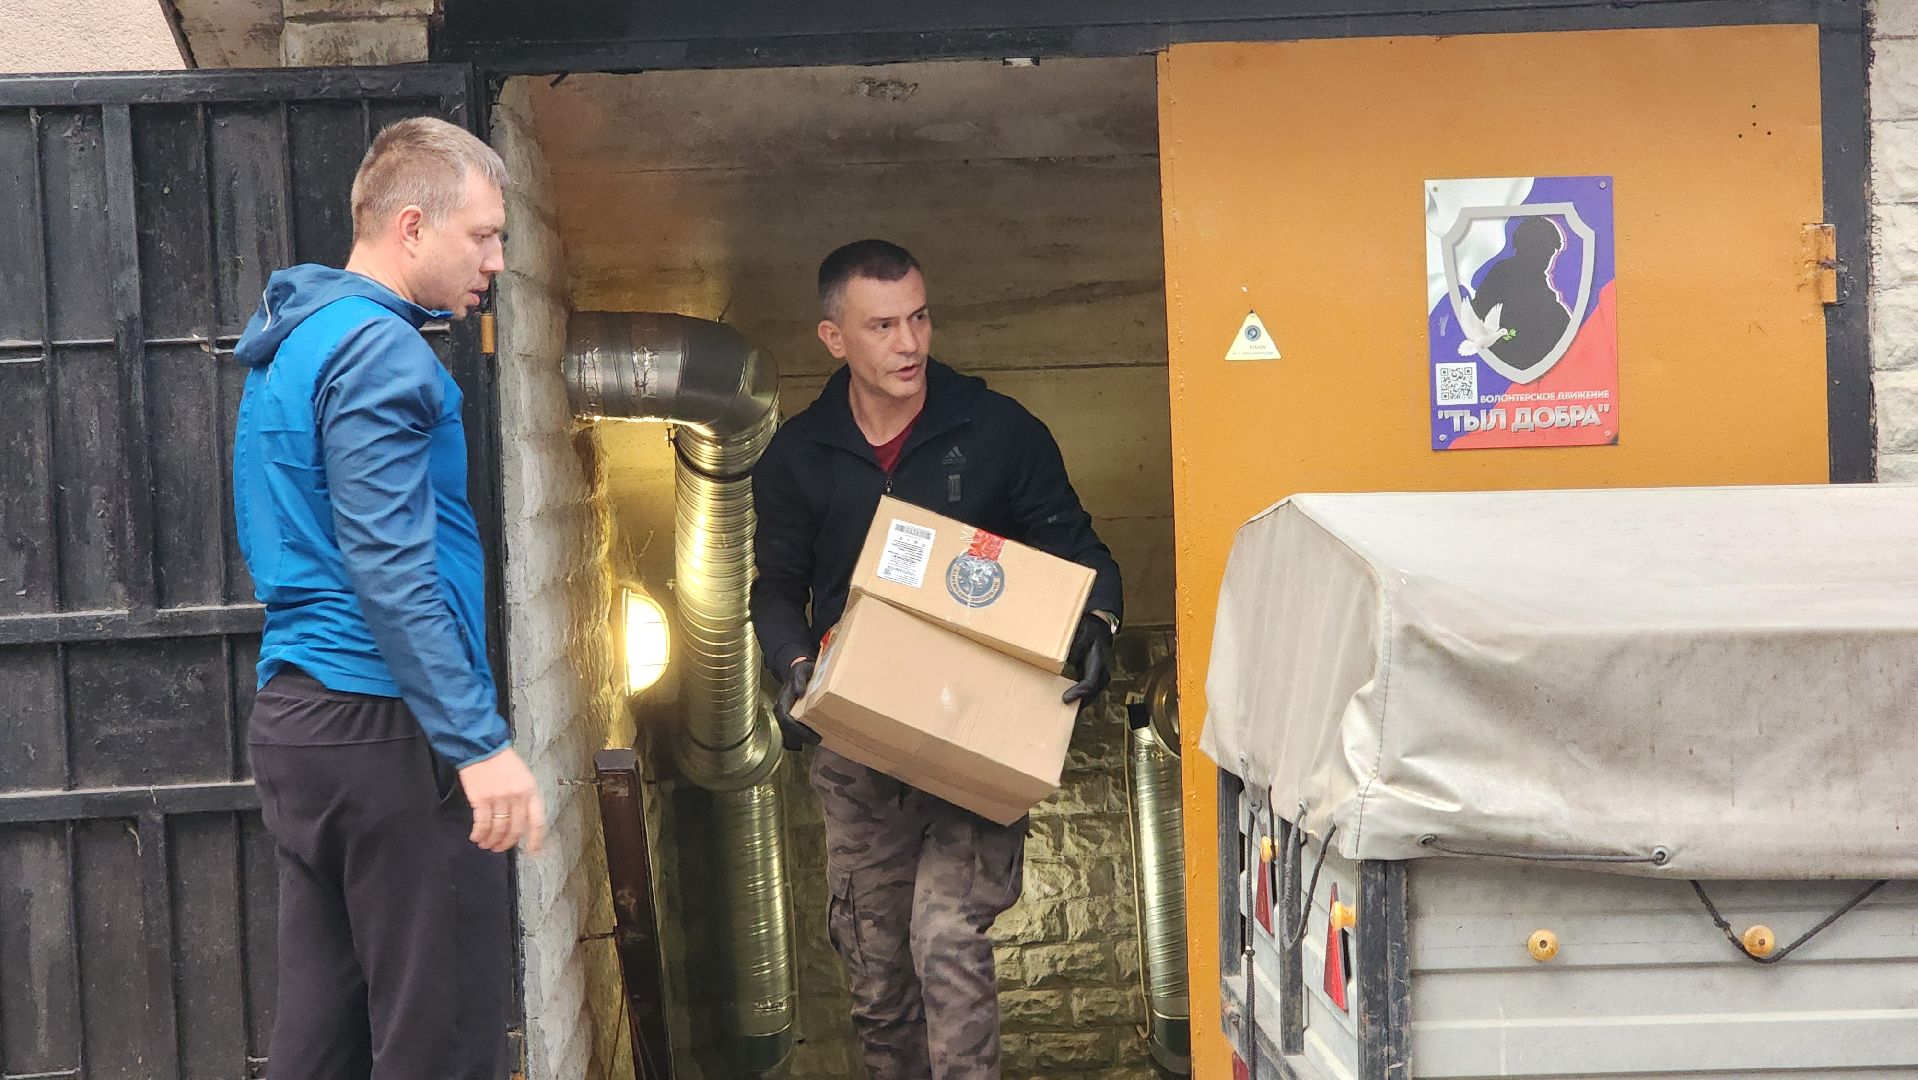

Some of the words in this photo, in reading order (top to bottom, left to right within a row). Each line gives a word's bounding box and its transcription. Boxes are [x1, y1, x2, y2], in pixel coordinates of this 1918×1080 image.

[1480, 391, 1556, 404] ВОЛОНТЕРСКОЕ
[1557, 389, 1610, 400] ДВИЖЕНИЕ
[1437, 408, 1507, 433] "ТЫЛ
[1511, 403, 1611, 433] ДОБРА"
